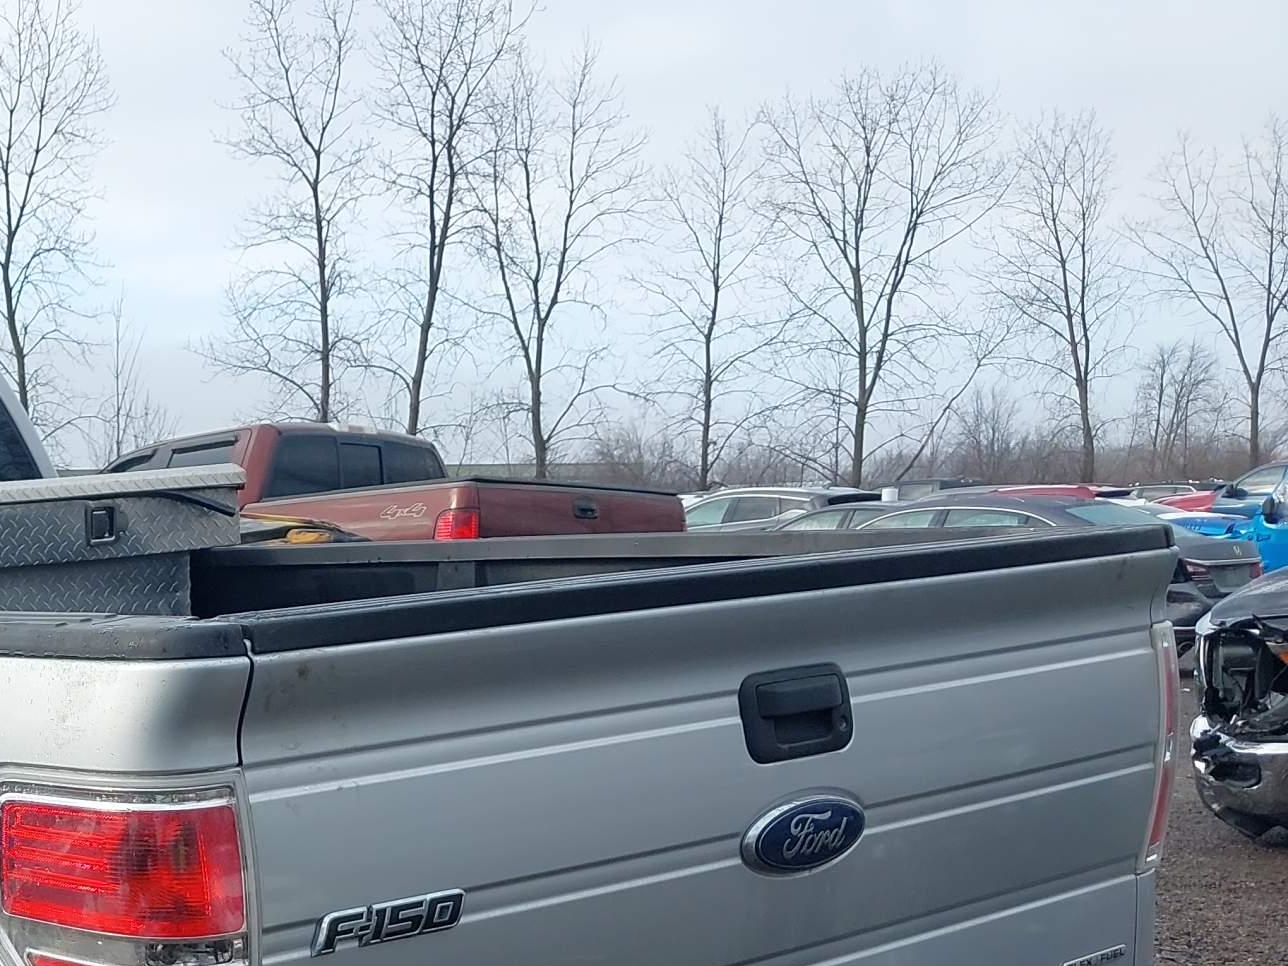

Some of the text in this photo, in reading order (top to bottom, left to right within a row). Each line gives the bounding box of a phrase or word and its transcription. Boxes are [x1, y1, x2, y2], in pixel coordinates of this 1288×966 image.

[380, 502, 427, 520] 4x4
[782, 809, 849, 860] Ford
[311, 888, 466, 957] F-150
[1100, 947, 1126, 962] FUEL
